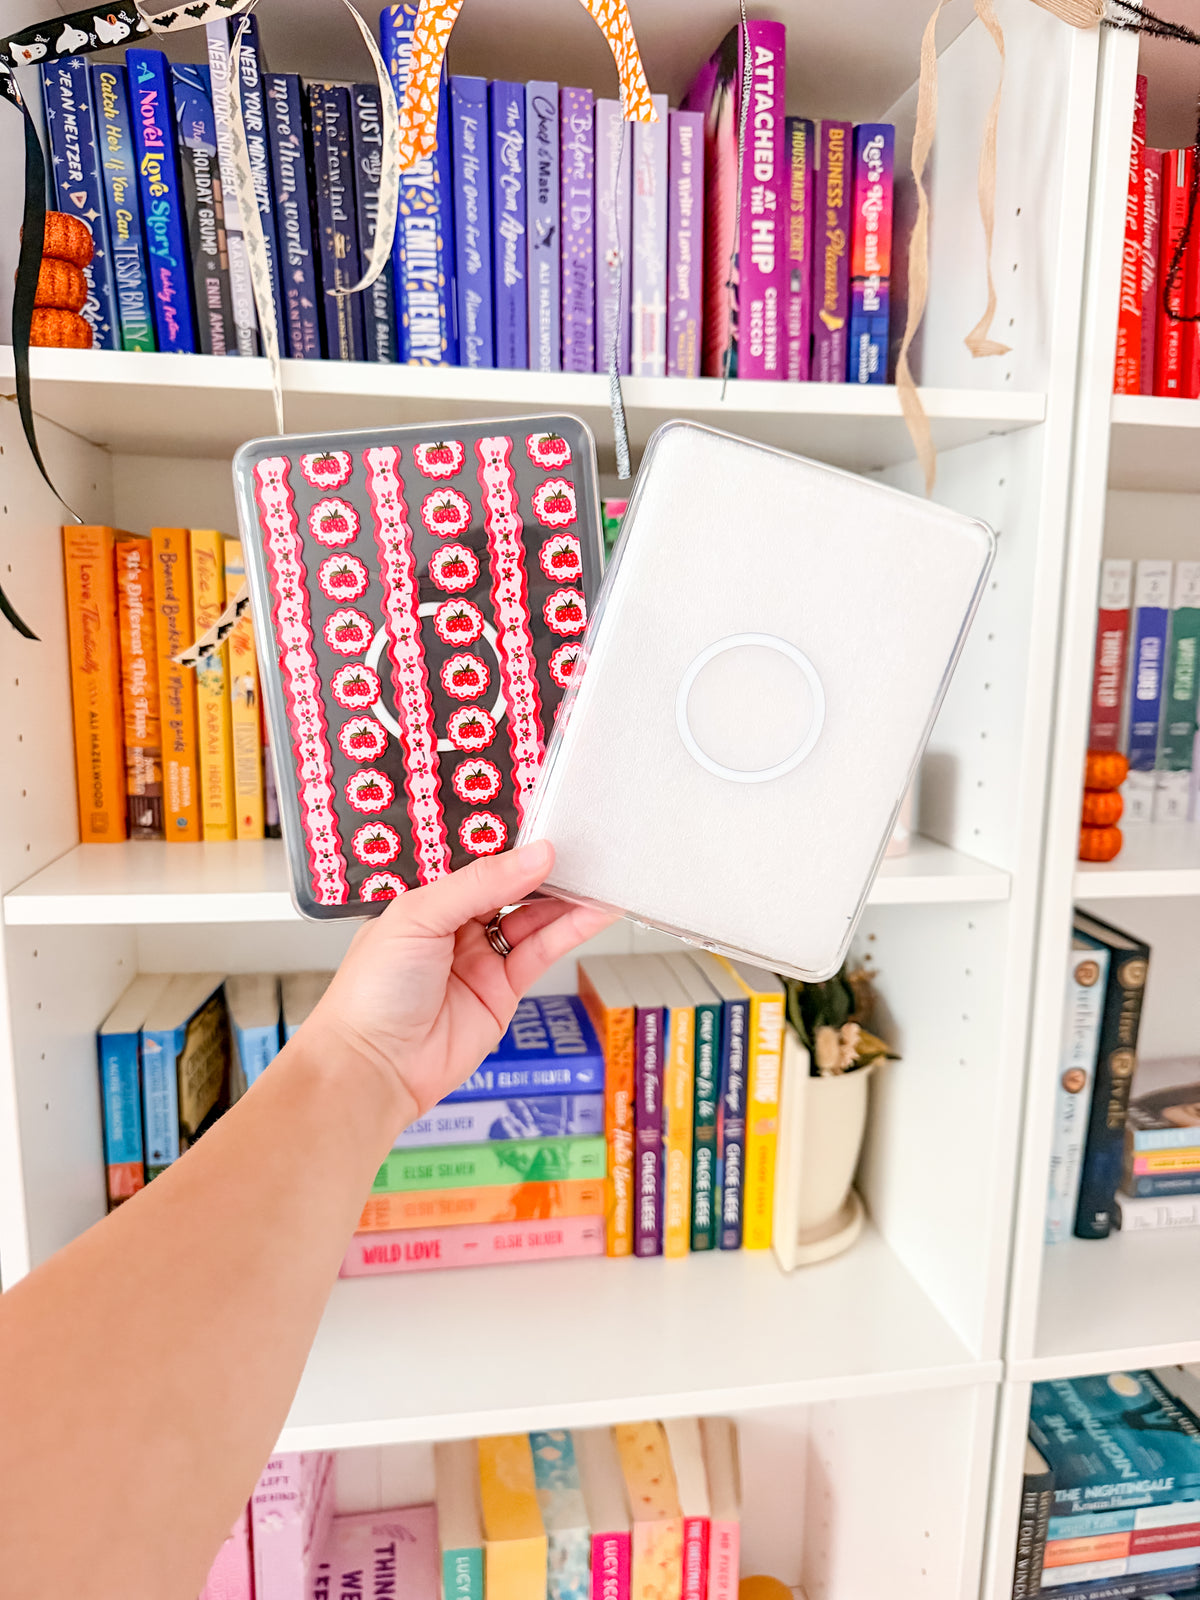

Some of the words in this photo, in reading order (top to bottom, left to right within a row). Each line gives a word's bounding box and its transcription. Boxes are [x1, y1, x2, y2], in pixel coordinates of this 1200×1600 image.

[137, 62, 156, 84] A
[208, 39, 227, 81] NEED
[240, 45, 257, 87] NEED
[58, 70, 75, 111] JEAN
[99, 72, 118, 120] Catch
[214, 87, 231, 125] YOUR
[243, 91, 261, 132] YOUR
[273, 78, 292, 136] more
[138, 89, 166, 149] Novel
[191, 121, 205, 142] The
[324, 102, 340, 137] the
[356, 94, 381, 147] JUST
[506, 101, 519, 128] The
[754, 45, 776, 182] ATTACHED
[63, 113, 84, 181] MELTZER
[106, 125, 124, 153] Her
[569, 114, 592, 180] Before
[678, 126, 693, 158] How
[862, 134, 884, 183] Let's
[109, 159, 127, 171] If
[140, 151, 170, 198] Love
[193, 148, 214, 205] HOLIDAY
[217, 131, 237, 195] NUMBER
[247, 135, 270, 214] MIDNIGHTS
[279, 140, 301, 194] than
[328, 146, 347, 222] rewind
[362, 151, 381, 184] my
[538, 161, 552, 205] Mate
[681, 161, 692, 174] to
[790, 131, 805, 212] HOUSEMAID'S
[826, 128, 843, 208] BUSINESS
[113, 175, 129, 206] You
[570, 187, 590, 198] I
[677, 178, 693, 217] Write
[750, 185, 763, 215] THE
[764, 190, 776, 209] AT
[861, 185, 885, 233] Kiss
[1125, 193, 1140, 228] we
[1142, 168, 1159, 249] Everything
[116, 208, 133, 240] Can
[147, 200, 176, 266] Story
[196, 207, 218, 256] GRUMP
[282, 201, 309, 266] words
[681, 219, 690, 227] a
[789, 215, 805, 262] SECRET
[826, 209, 838, 226] or
[116, 243, 140, 291] TESSA
[229, 236, 246, 293] MARIAH
[404, 216, 438, 283] EMILY
[499, 212, 524, 288] Agenda
[677, 230, 693, 263] Love
[751, 220, 776, 274] HIP
[863, 234, 879, 272] and
[540, 262, 551, 284] ALI
[571, 260, 588, 313] SOPHIE
[677, 264, 691, 300] Story
[823, 228, 845, 312] Pleasure
[1120, 238, 1142, 316] found
[205, 277, 221, 309] ENNI
[862, 274, 879, 312] Tell
[121, 292, 148, 343] BAILEY
[304, 320, 315, 352] JILL
[408, 291, 442, 361] HENRY
[750, 300, 763, 357] RICCIO
[763, 287, 777, 371] CHRISTINE
[1167, 330, 1179, 372] PROSE
[79, 564, 95, 605] Love,
[126, 551, 140, 581] It's
[159, 552, 179, 602] Banned
[194, 547, 217, 593] Twice
[126, 582, 144, 656] Different
[130, 658, 146, 696] This
[87, 711, 101, 729] ALI
[135, 697, 150, 739] Time
[206, 702, 220, 755] SARAH
[91, 733, 104, 809] HAZELWOOD
[208, 764, 224, 809] HOGLE
[645, 1012, 657, 1043] WITH
[730, 1005, 744, 1034] EVER
[759, 1001, 781, 1053] HAPPY
[497, 1072, 531, 1088] ELSIE
[533, 1069, 571, 1085] SILVER
[436, 1116, 475, 1131] SILVER
[403, 1164, 433, 1180] ELSIE
[438, 1162, 476, 1177] SILVER
[642, 1151, 656, 1195] CHLOE
[696, 1147, 711, 1191] CHLOE
[725, 1142, 740, 1187] CHLOE
[640, 1196, 655, 1231] LIESE
[695, 1191, 710, 1228] LIESE
[724, 1187, 739, 1223] LIESE
[362, 1245, 402, 1264] WILD
[405, 1240, 441, 1261] LOVE
[493, 1234, 523, 1251] ELSIE
[528, 1231, 564, 1246] SILVER
[1053, 1487, 1082, 1503] THE
[1084, 1477, 1176, 1498] NIGHTINGALE
[455, 1556, 470, 1593] LUCY
[602, 1539, 619, 1576] LUCY
